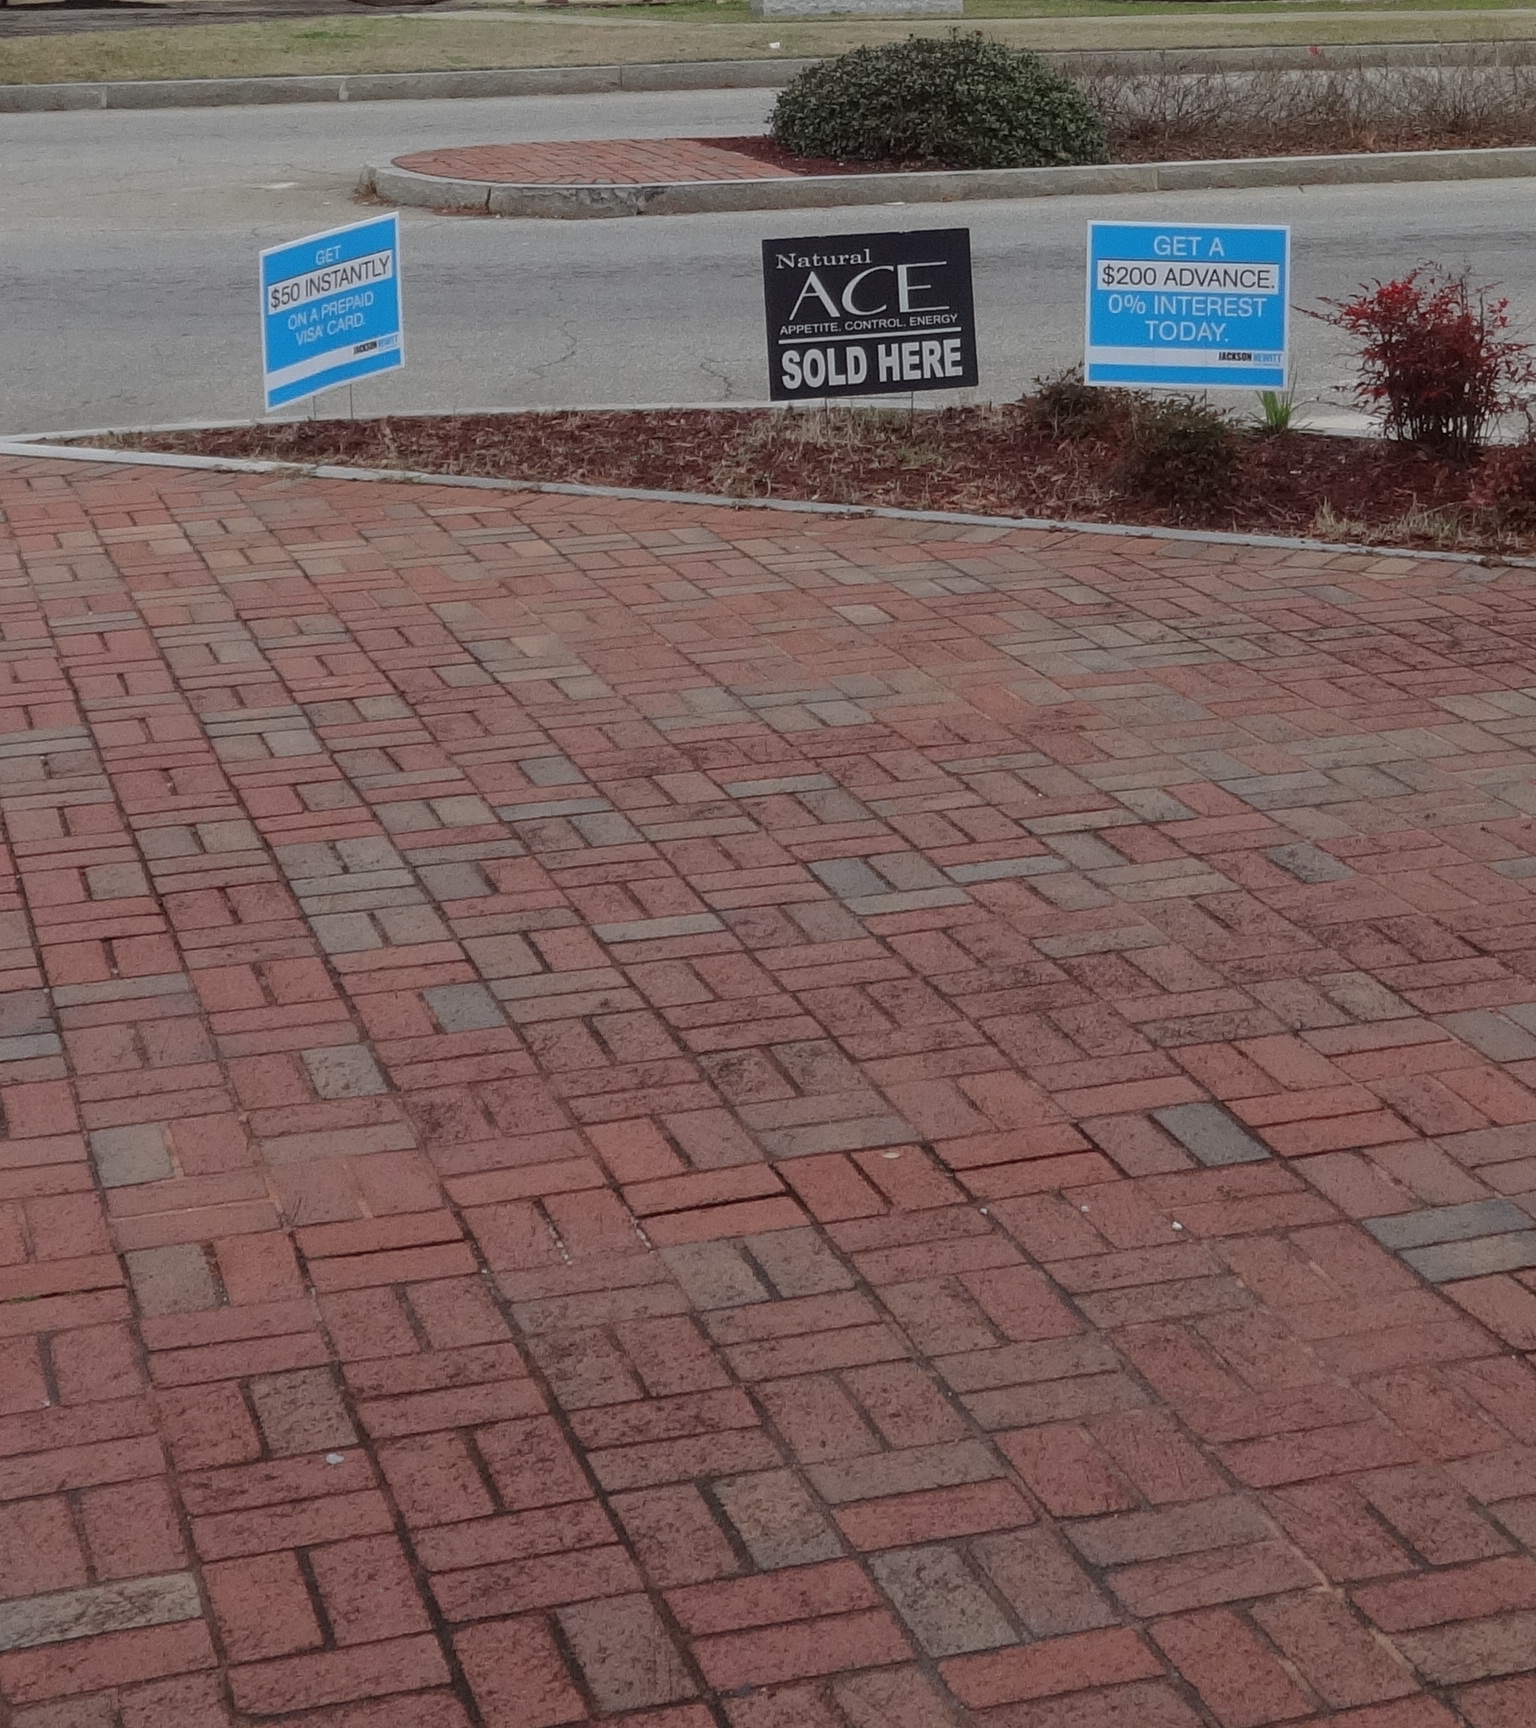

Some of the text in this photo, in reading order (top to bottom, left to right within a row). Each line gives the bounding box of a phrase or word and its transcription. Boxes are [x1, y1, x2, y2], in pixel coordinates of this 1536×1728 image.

[316, 245, 341, 266] GET
[1153, 236, 1225, 257] GET A
[776, 248, 873, 269] Natural
[271, 255, 390, 310] $50 INSTANTLY
[1102, 264, 1275, 289] $200 ADVANCE.
[789, 261, 950, 321] ACE
[288, 291, 374, 330] ON A PREPAID
[1108, 294, 1267, 317] 0% INTEREST
[327, 312, 366, 335] CARD.
[779, 313, 958, 335] APPETITE. CONTROL. ENERGY
[1145, 320, 1229, 342] TODAY.
[781, 338, 963, 389] SOLD HERE
[1218, 351, 1252, 362] JACKSON
